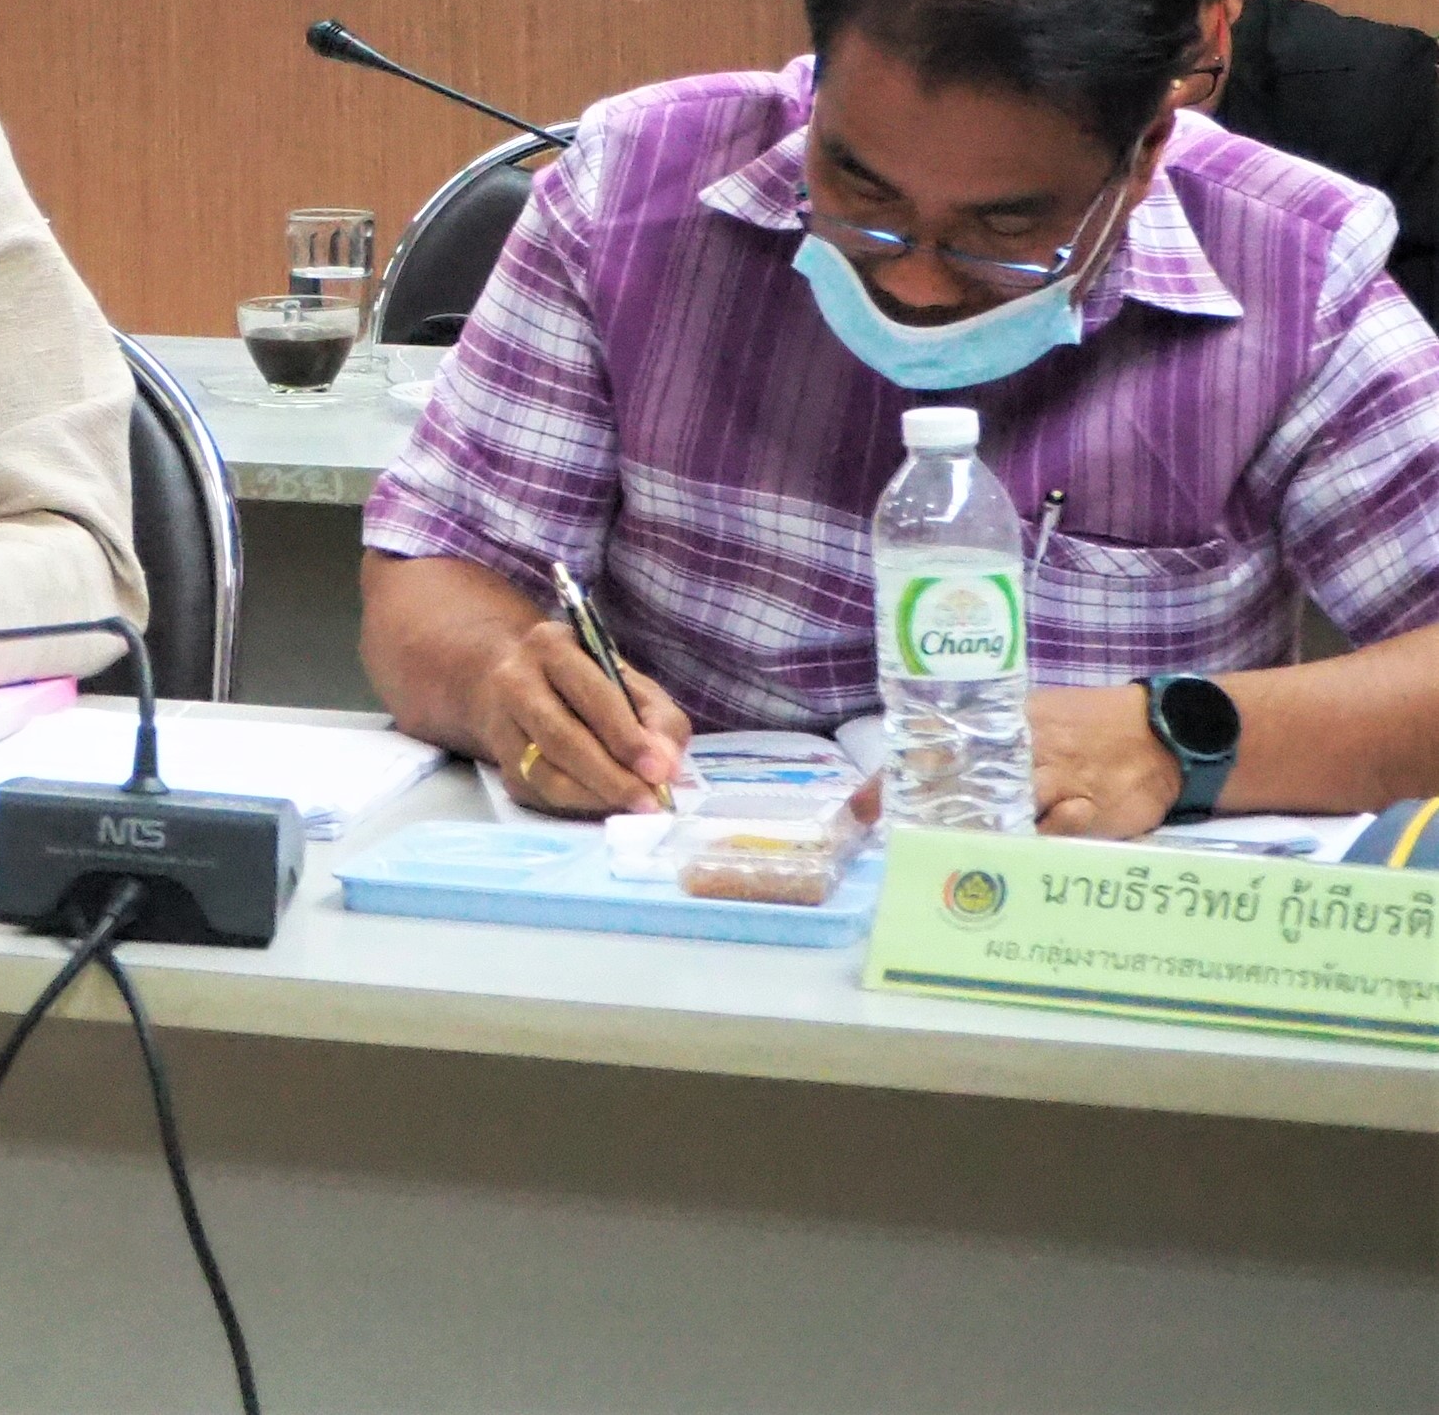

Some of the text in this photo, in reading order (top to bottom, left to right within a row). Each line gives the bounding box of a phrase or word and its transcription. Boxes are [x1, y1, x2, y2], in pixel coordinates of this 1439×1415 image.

[920, 630, 1005, 657] Chang
[1041, 867, 1265, 922] นายธีรวิทย์
[984, 935, 1439, 1009] ผอ.กลุ่มงานสารสนเทศการพัฒนาชุม
